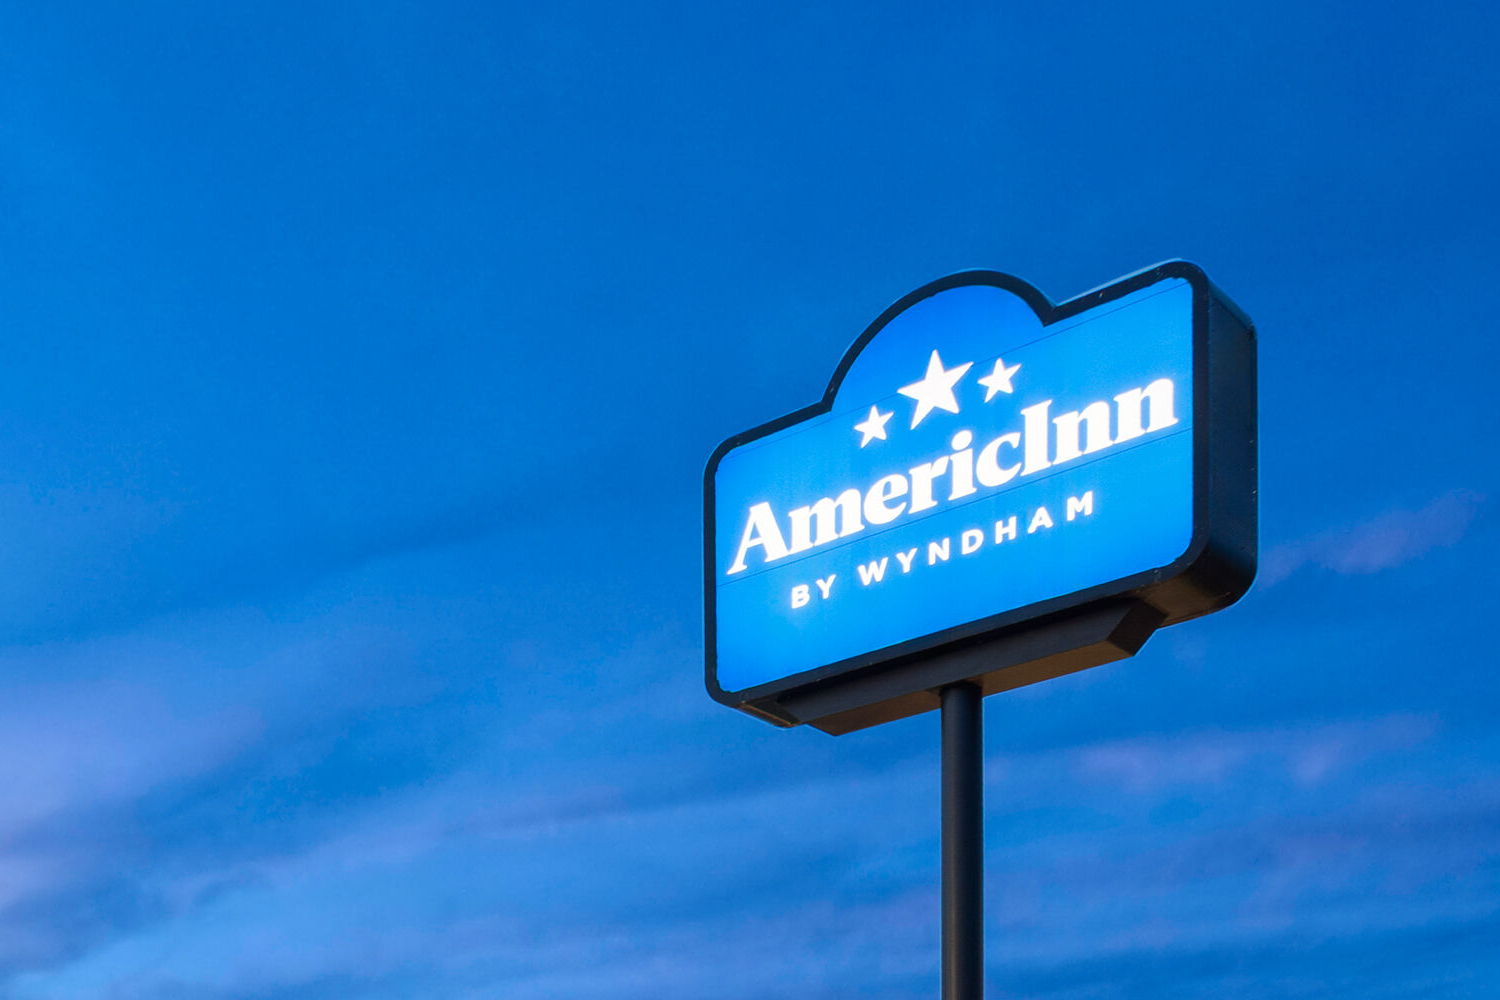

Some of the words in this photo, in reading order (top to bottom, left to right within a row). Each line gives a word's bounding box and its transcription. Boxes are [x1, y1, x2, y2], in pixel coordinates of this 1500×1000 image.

[727, 377, 1178, 575] AmericInn
[790, 574, 836, 609] BY
[857, 490, 1095, 586] WYNDHAM
